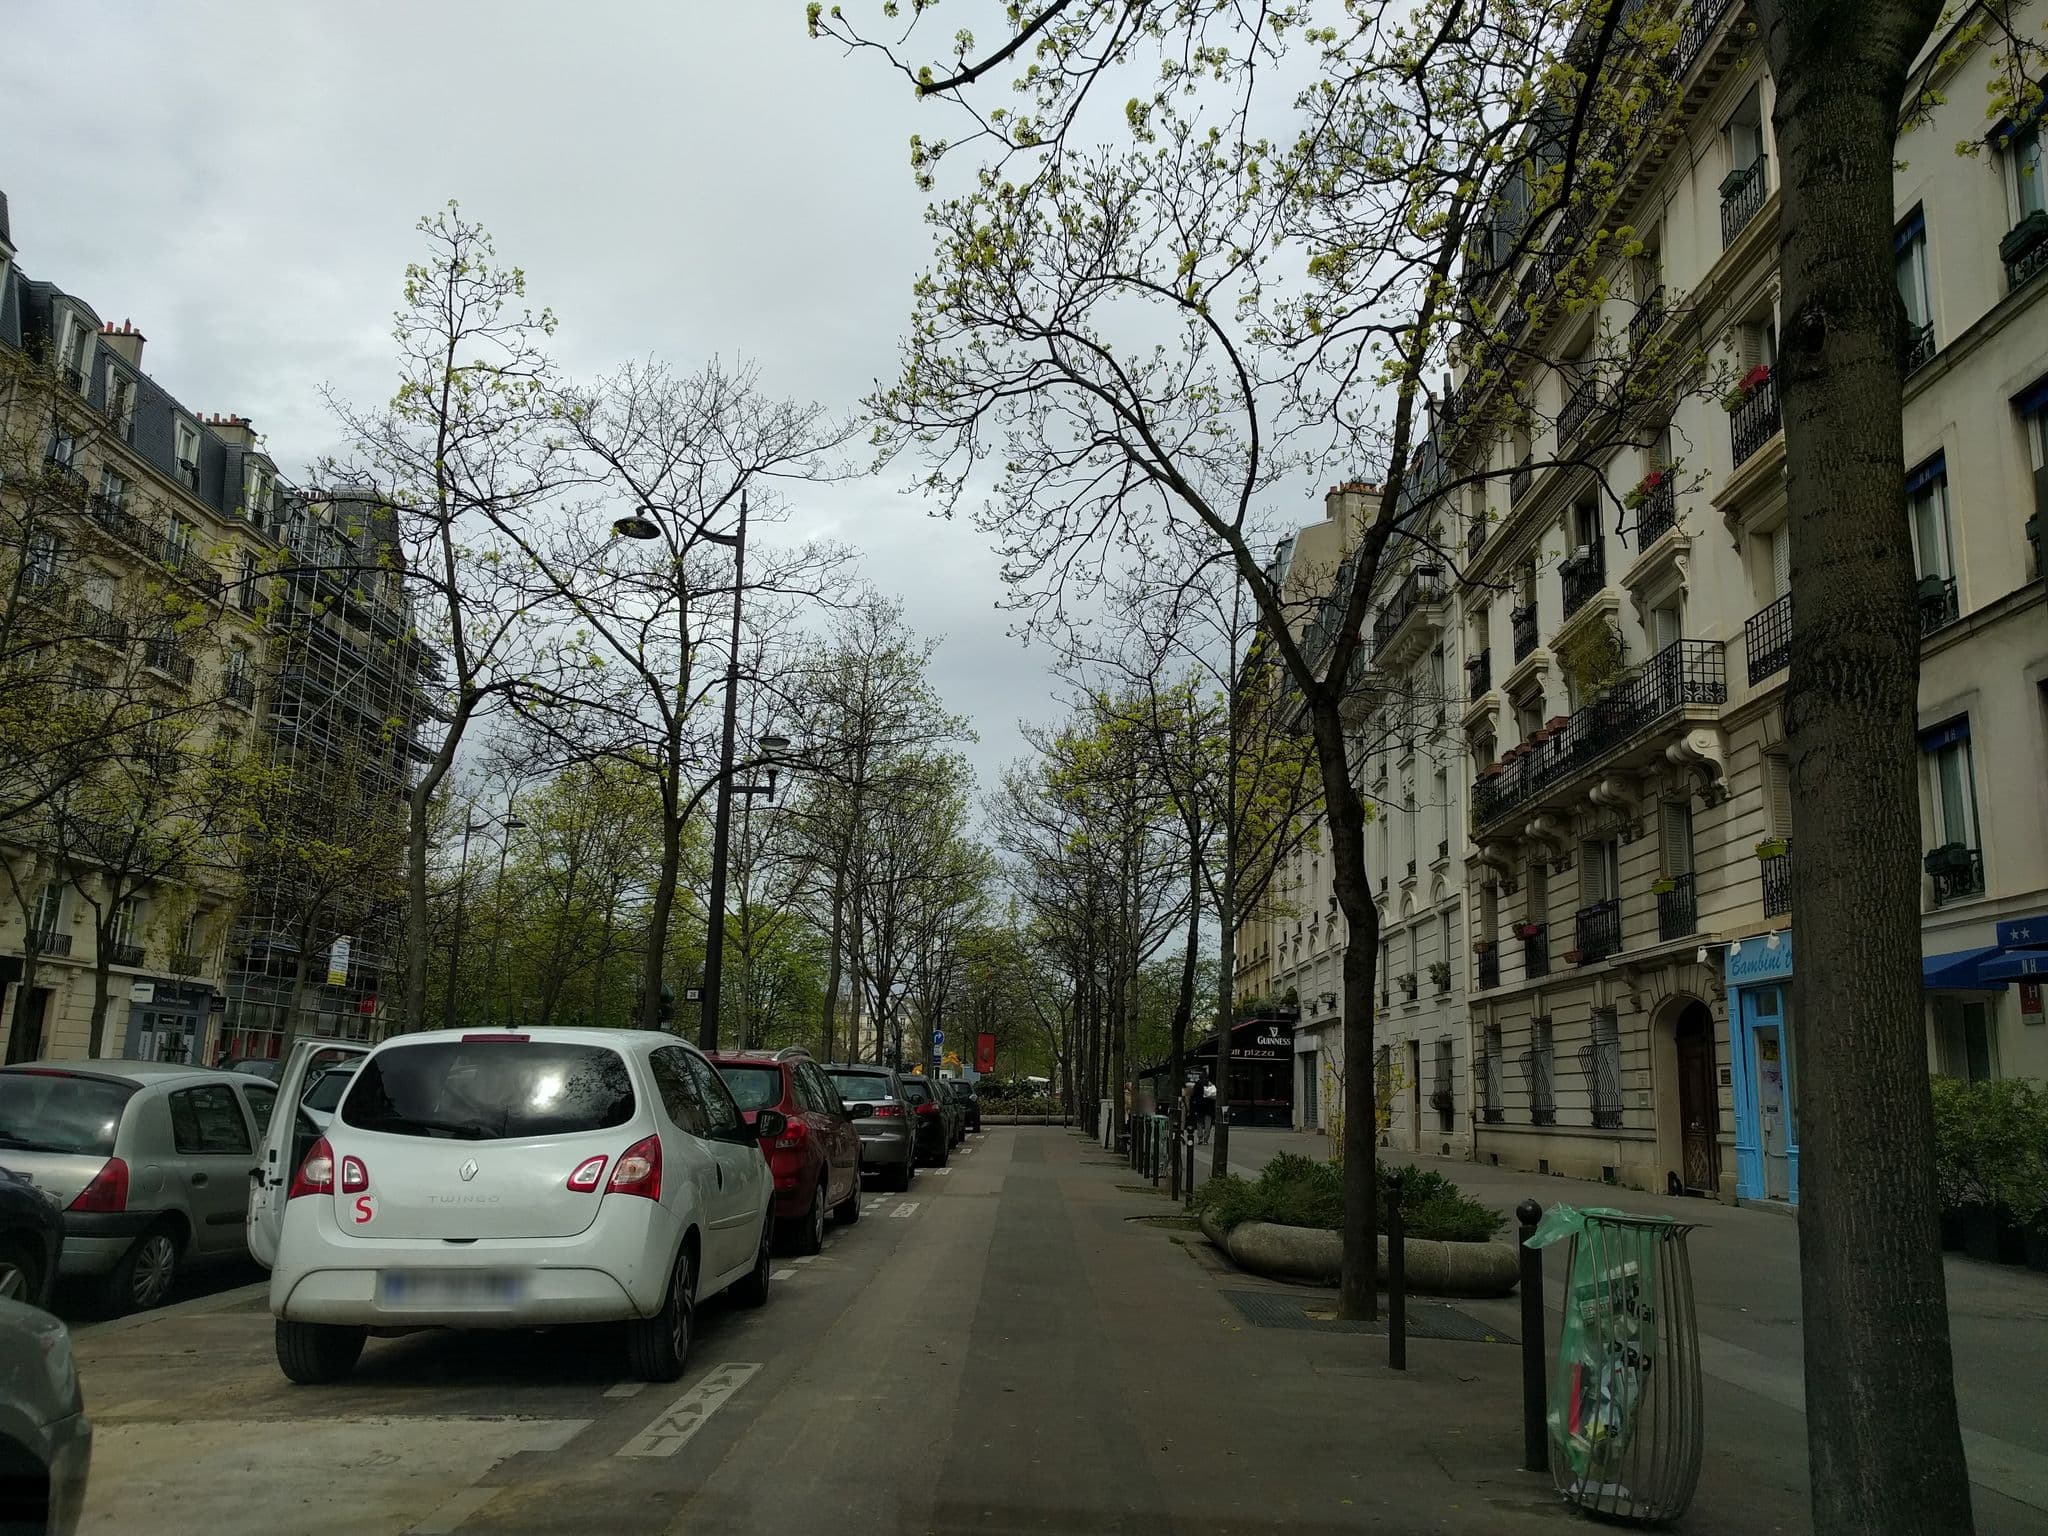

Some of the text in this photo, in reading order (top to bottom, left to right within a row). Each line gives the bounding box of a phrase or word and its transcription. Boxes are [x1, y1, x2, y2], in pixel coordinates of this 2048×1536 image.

[1257, 1035, 1291, 1046] GUINNESS
[1244, 1048, 1275, 1057] pizza
[428, 1195, 500, 1203] TWINGO
[355, 1195, 373, 1224] S
